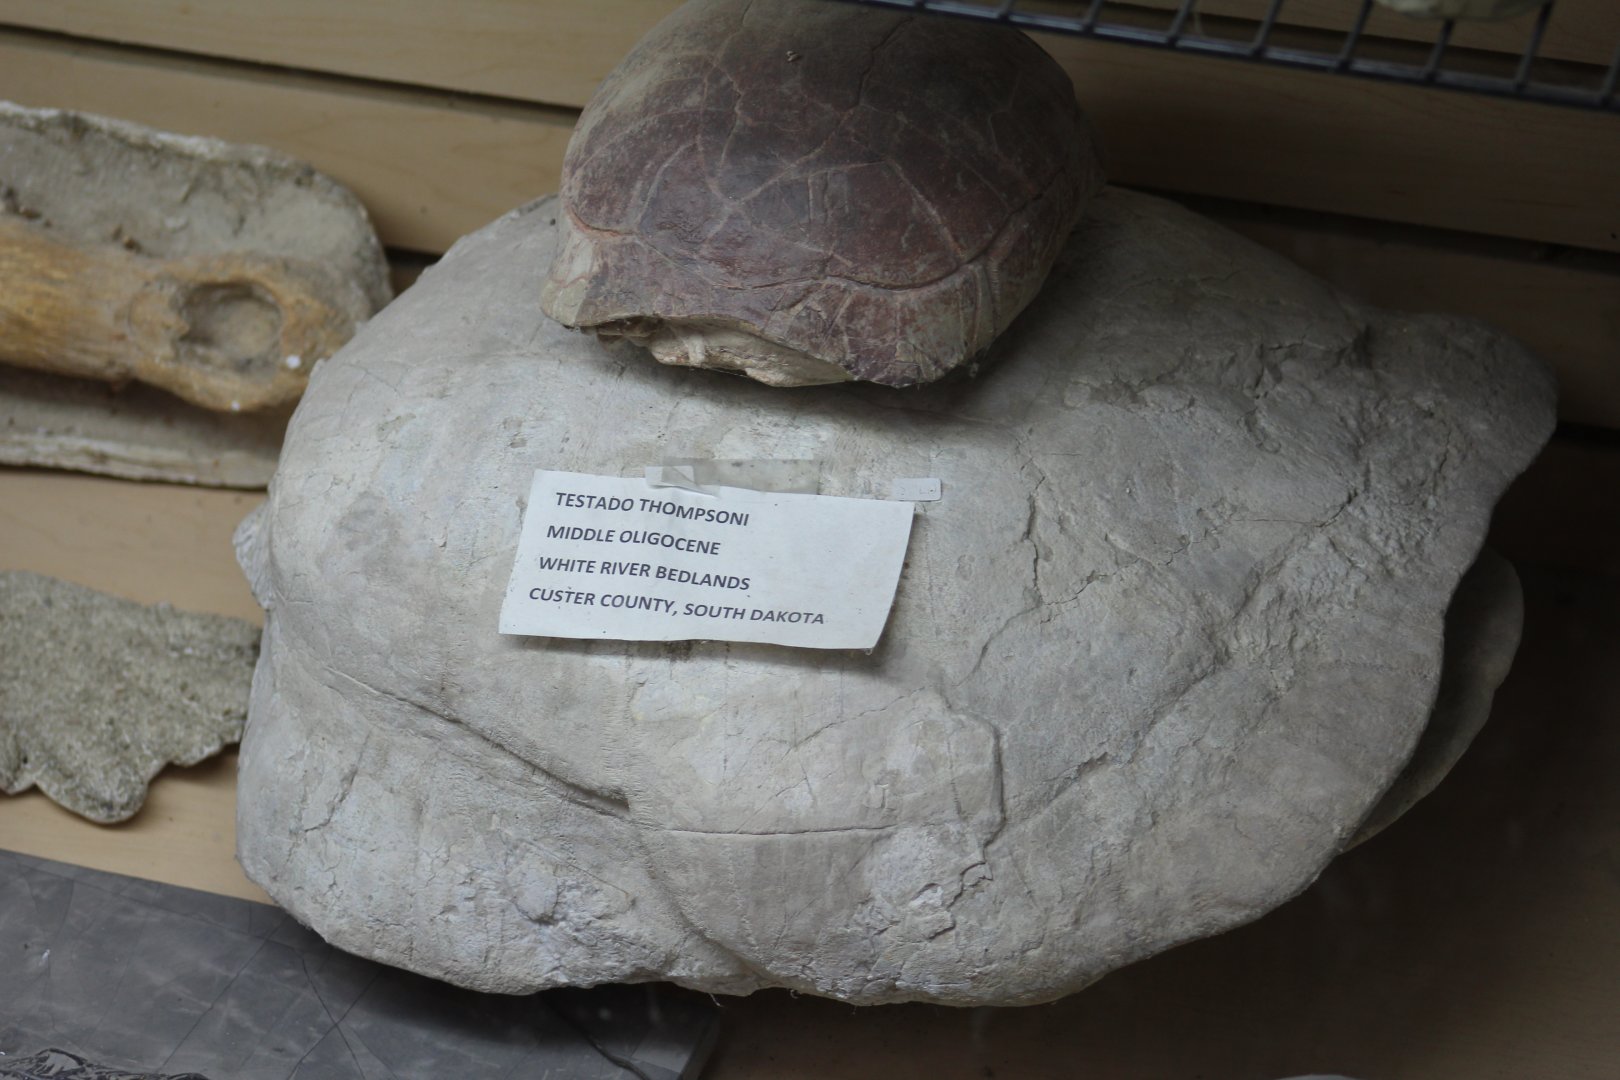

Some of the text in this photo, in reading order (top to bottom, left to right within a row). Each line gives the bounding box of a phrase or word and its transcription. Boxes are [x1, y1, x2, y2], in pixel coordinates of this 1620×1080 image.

[555, 491, 750, 527] TESTADO THOMPSONI
[546, 524, 721, 556] MIDDLE OLIGOCENE
[539, 556, 751, 591] WHITE RIVER BEDLANDS
[529, 586, 825, 626] CUSTER COUNTY, SOUTH DAKOTA
